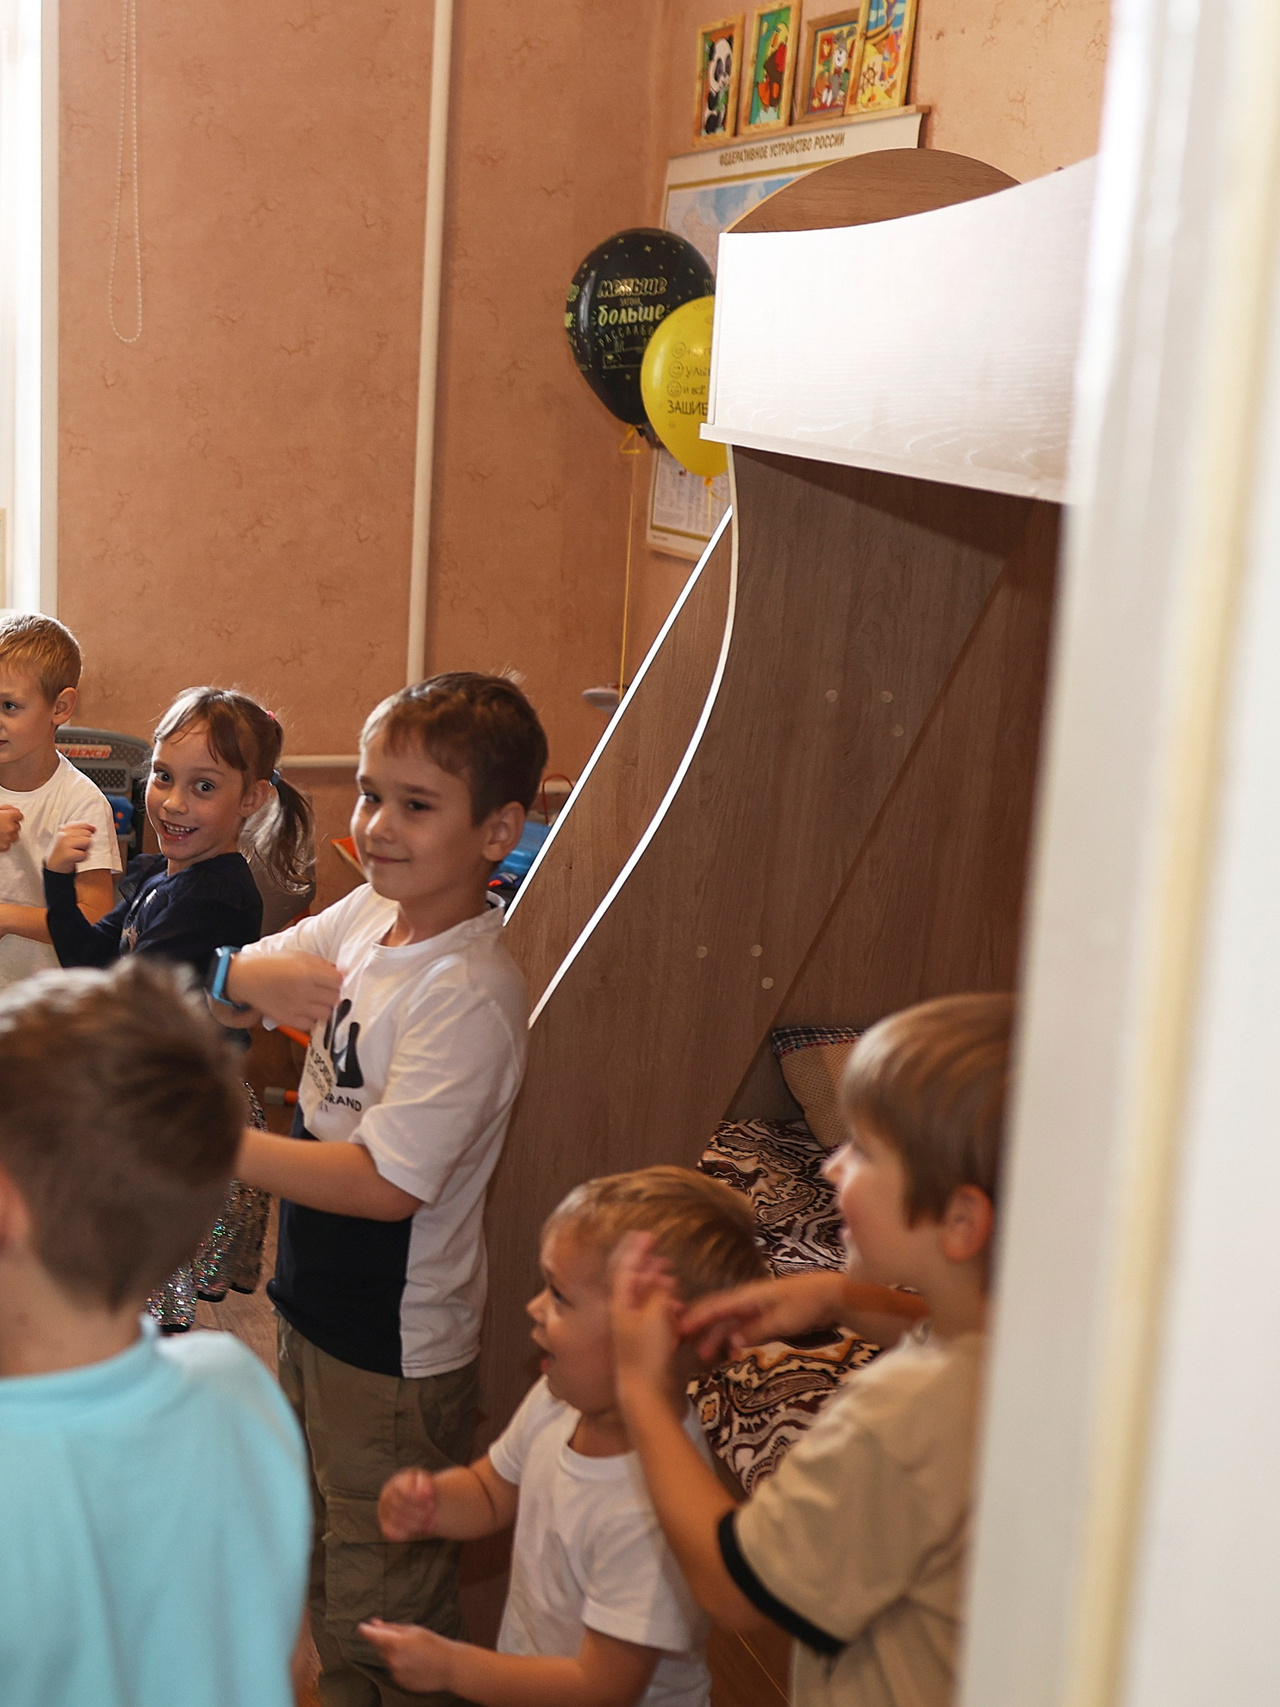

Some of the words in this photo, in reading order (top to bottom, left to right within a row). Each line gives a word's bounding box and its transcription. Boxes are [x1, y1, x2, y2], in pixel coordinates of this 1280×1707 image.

[769, 137, 812, 157] УСТРОЙСТВО
[814, 132, 845, 150] РОССИИ
[598, 303, 666, 326] больше
